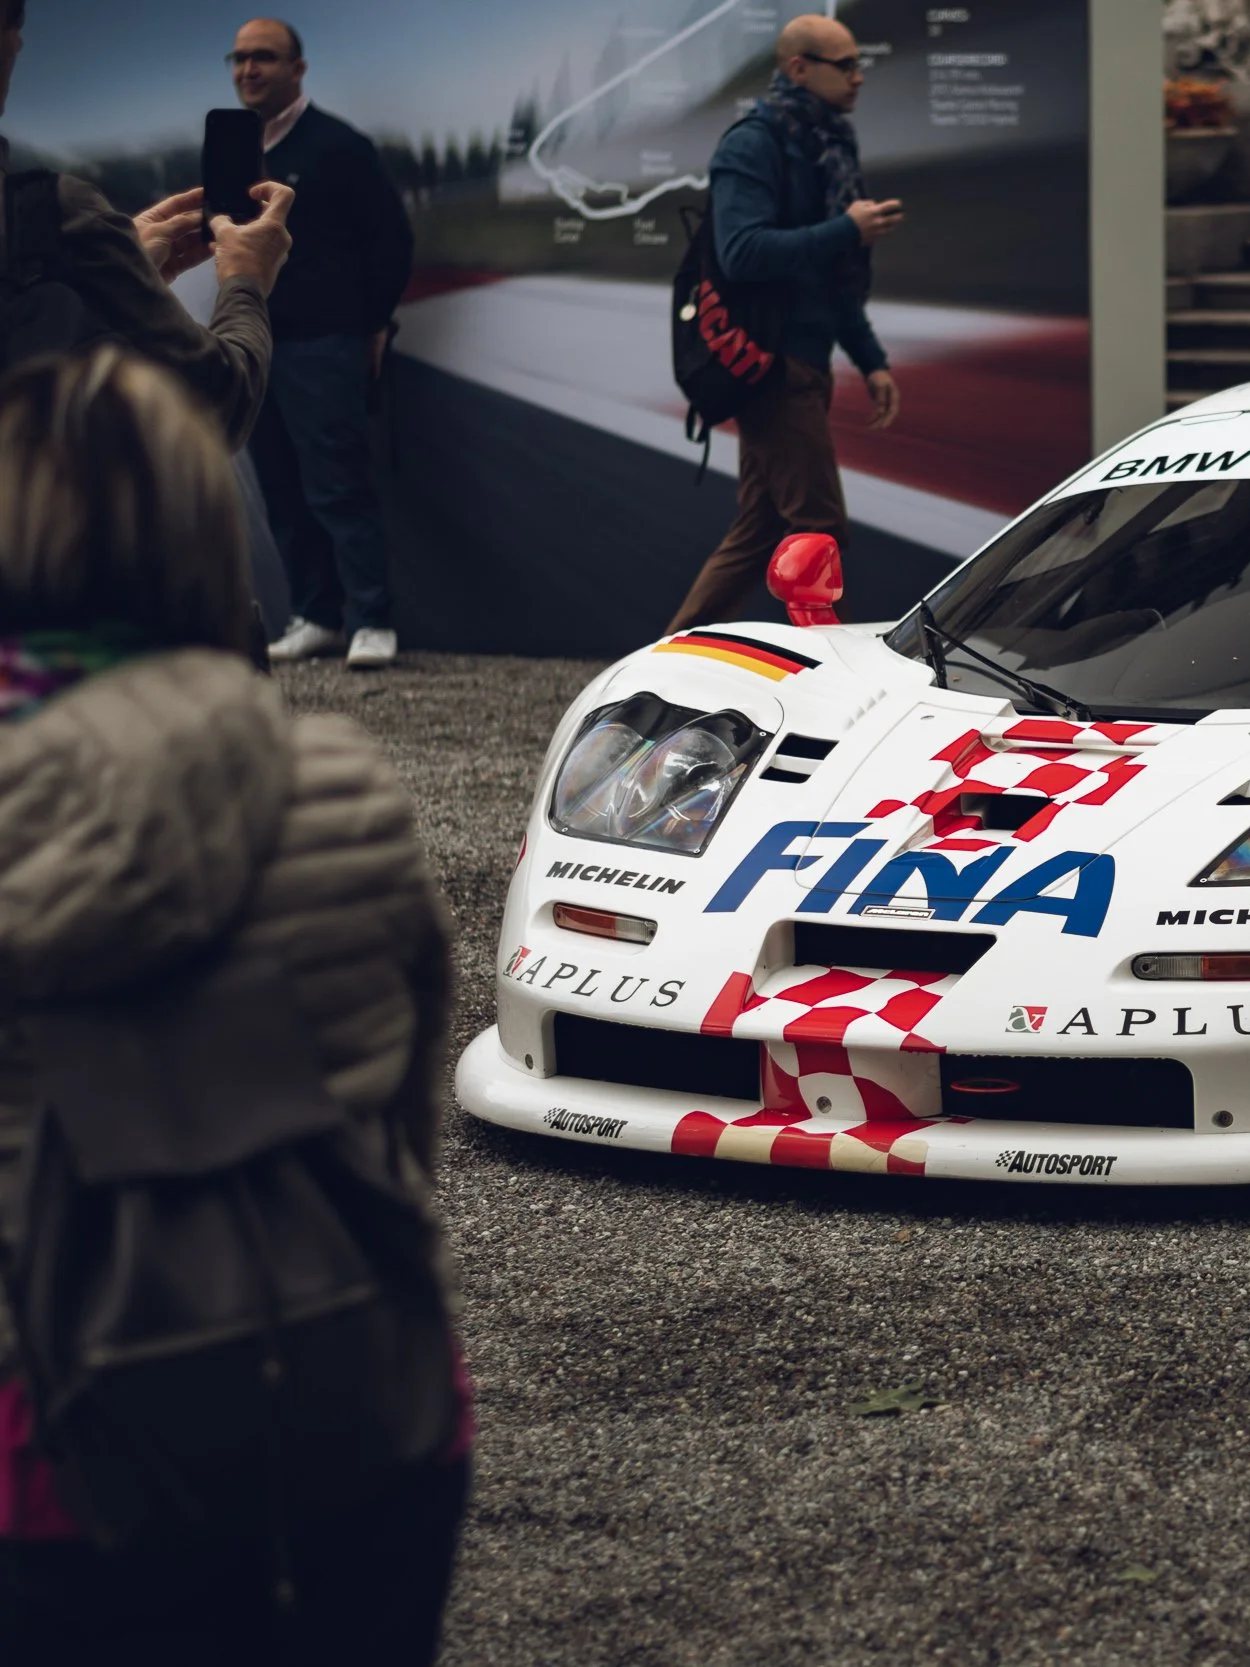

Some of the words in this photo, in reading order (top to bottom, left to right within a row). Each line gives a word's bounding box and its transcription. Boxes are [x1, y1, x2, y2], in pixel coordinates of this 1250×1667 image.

[545, 861, 687, 894] MICHELIN
[702, 820, 1116, 938] FINA
[516, 955, 687, 1007] APLUS
